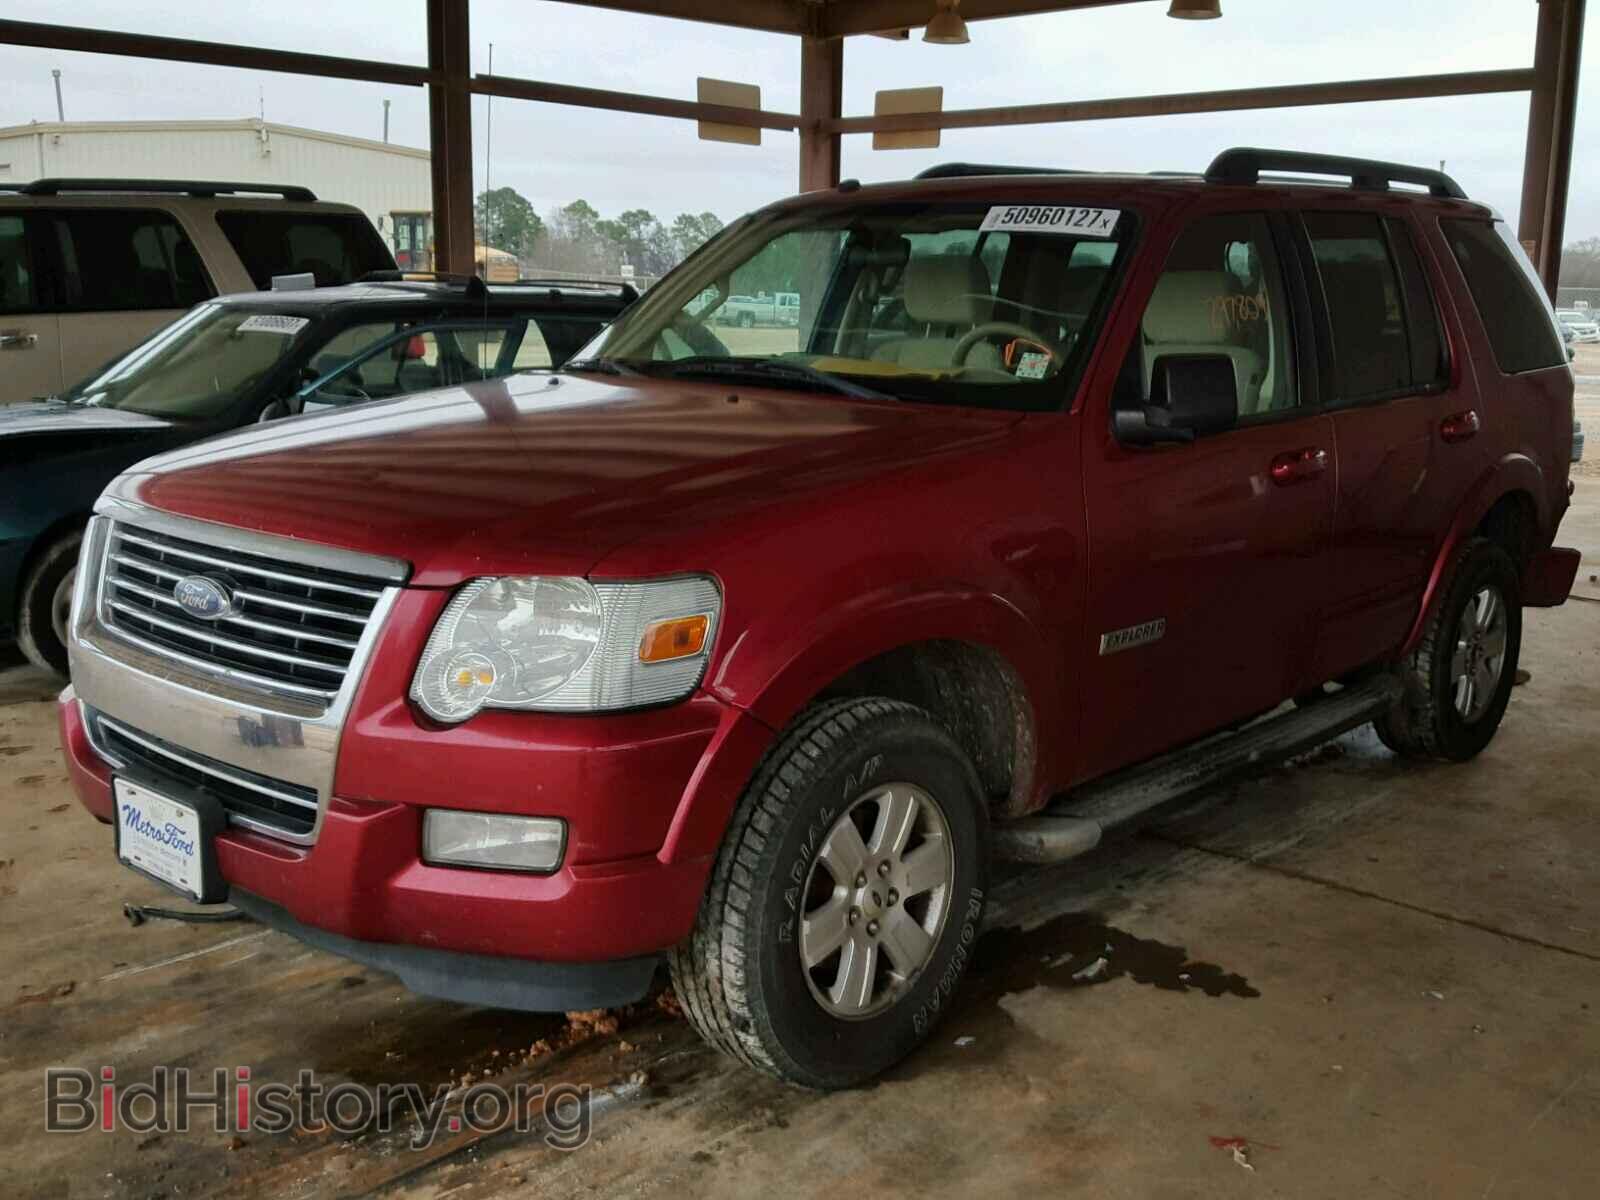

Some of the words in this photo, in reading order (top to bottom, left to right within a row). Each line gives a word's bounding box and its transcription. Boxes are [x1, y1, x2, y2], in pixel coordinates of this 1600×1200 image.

[1001, 207, 1103, 228] 50960127
[180, 583, 210, 611] Ford
[1102, 620, 1164, 650] EXPLORER
[779, 807, 836, 942] RADIAL
[911, 887, 984, 1034] IRONMAN
